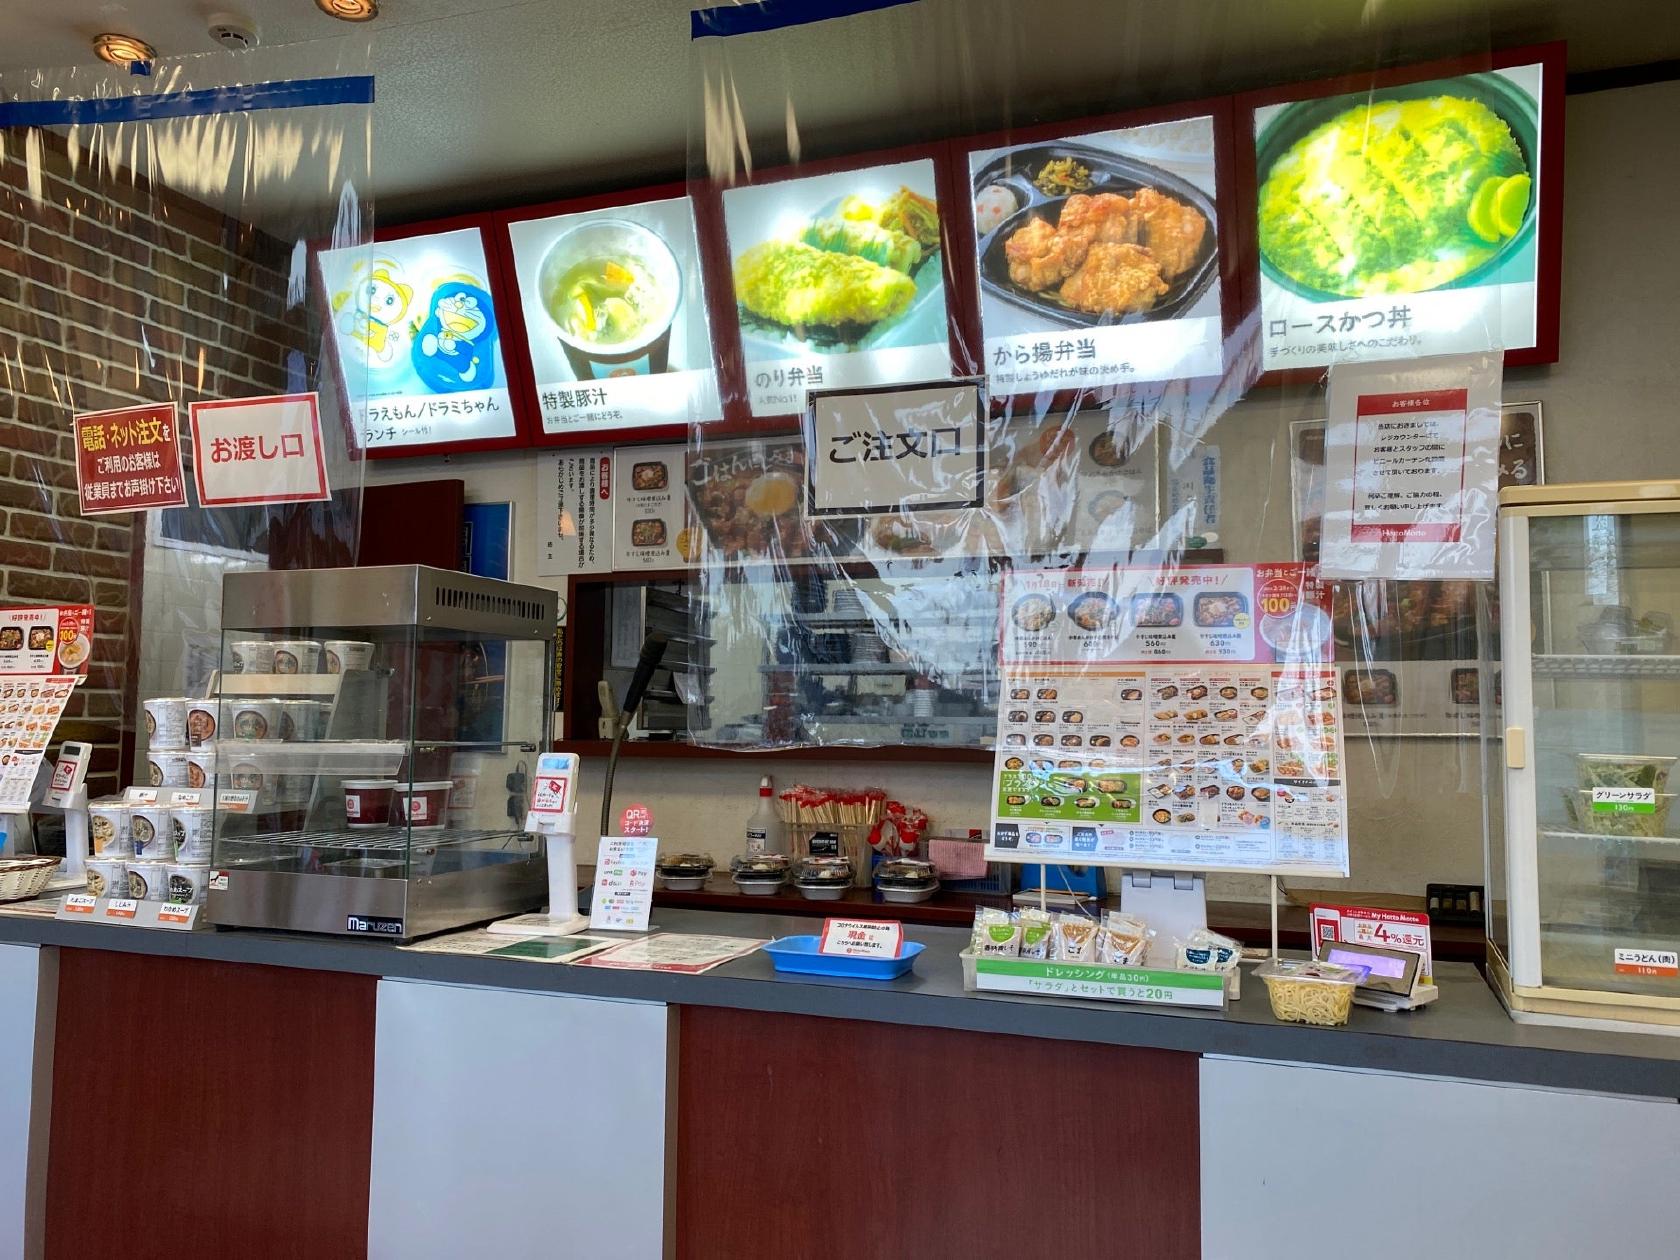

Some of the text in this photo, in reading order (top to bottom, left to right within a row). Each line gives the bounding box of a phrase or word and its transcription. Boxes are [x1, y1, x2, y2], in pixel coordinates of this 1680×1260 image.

[1269, 305, 1412, 338] ロースかつ丼
[994, 338, 1097, 366] から揚弁当
[755, 364, 823, 388] のり弁当
[541, 387, 608, 410] 特製豚汁
[210, 433, 305, 464] お渡し口
[829, 427, 961, 464] ご注文口
[97, 451, 161, 475] ご利用のお客様は
[84, 476, 179, 501] 従業員までお声掛け下さい
[1596, 791, 1652, 800] グリーンサラダ
[347, 917, 402, 931] Maruzen
[1619, 952, 1675, 964] ミニうどん(肉)
